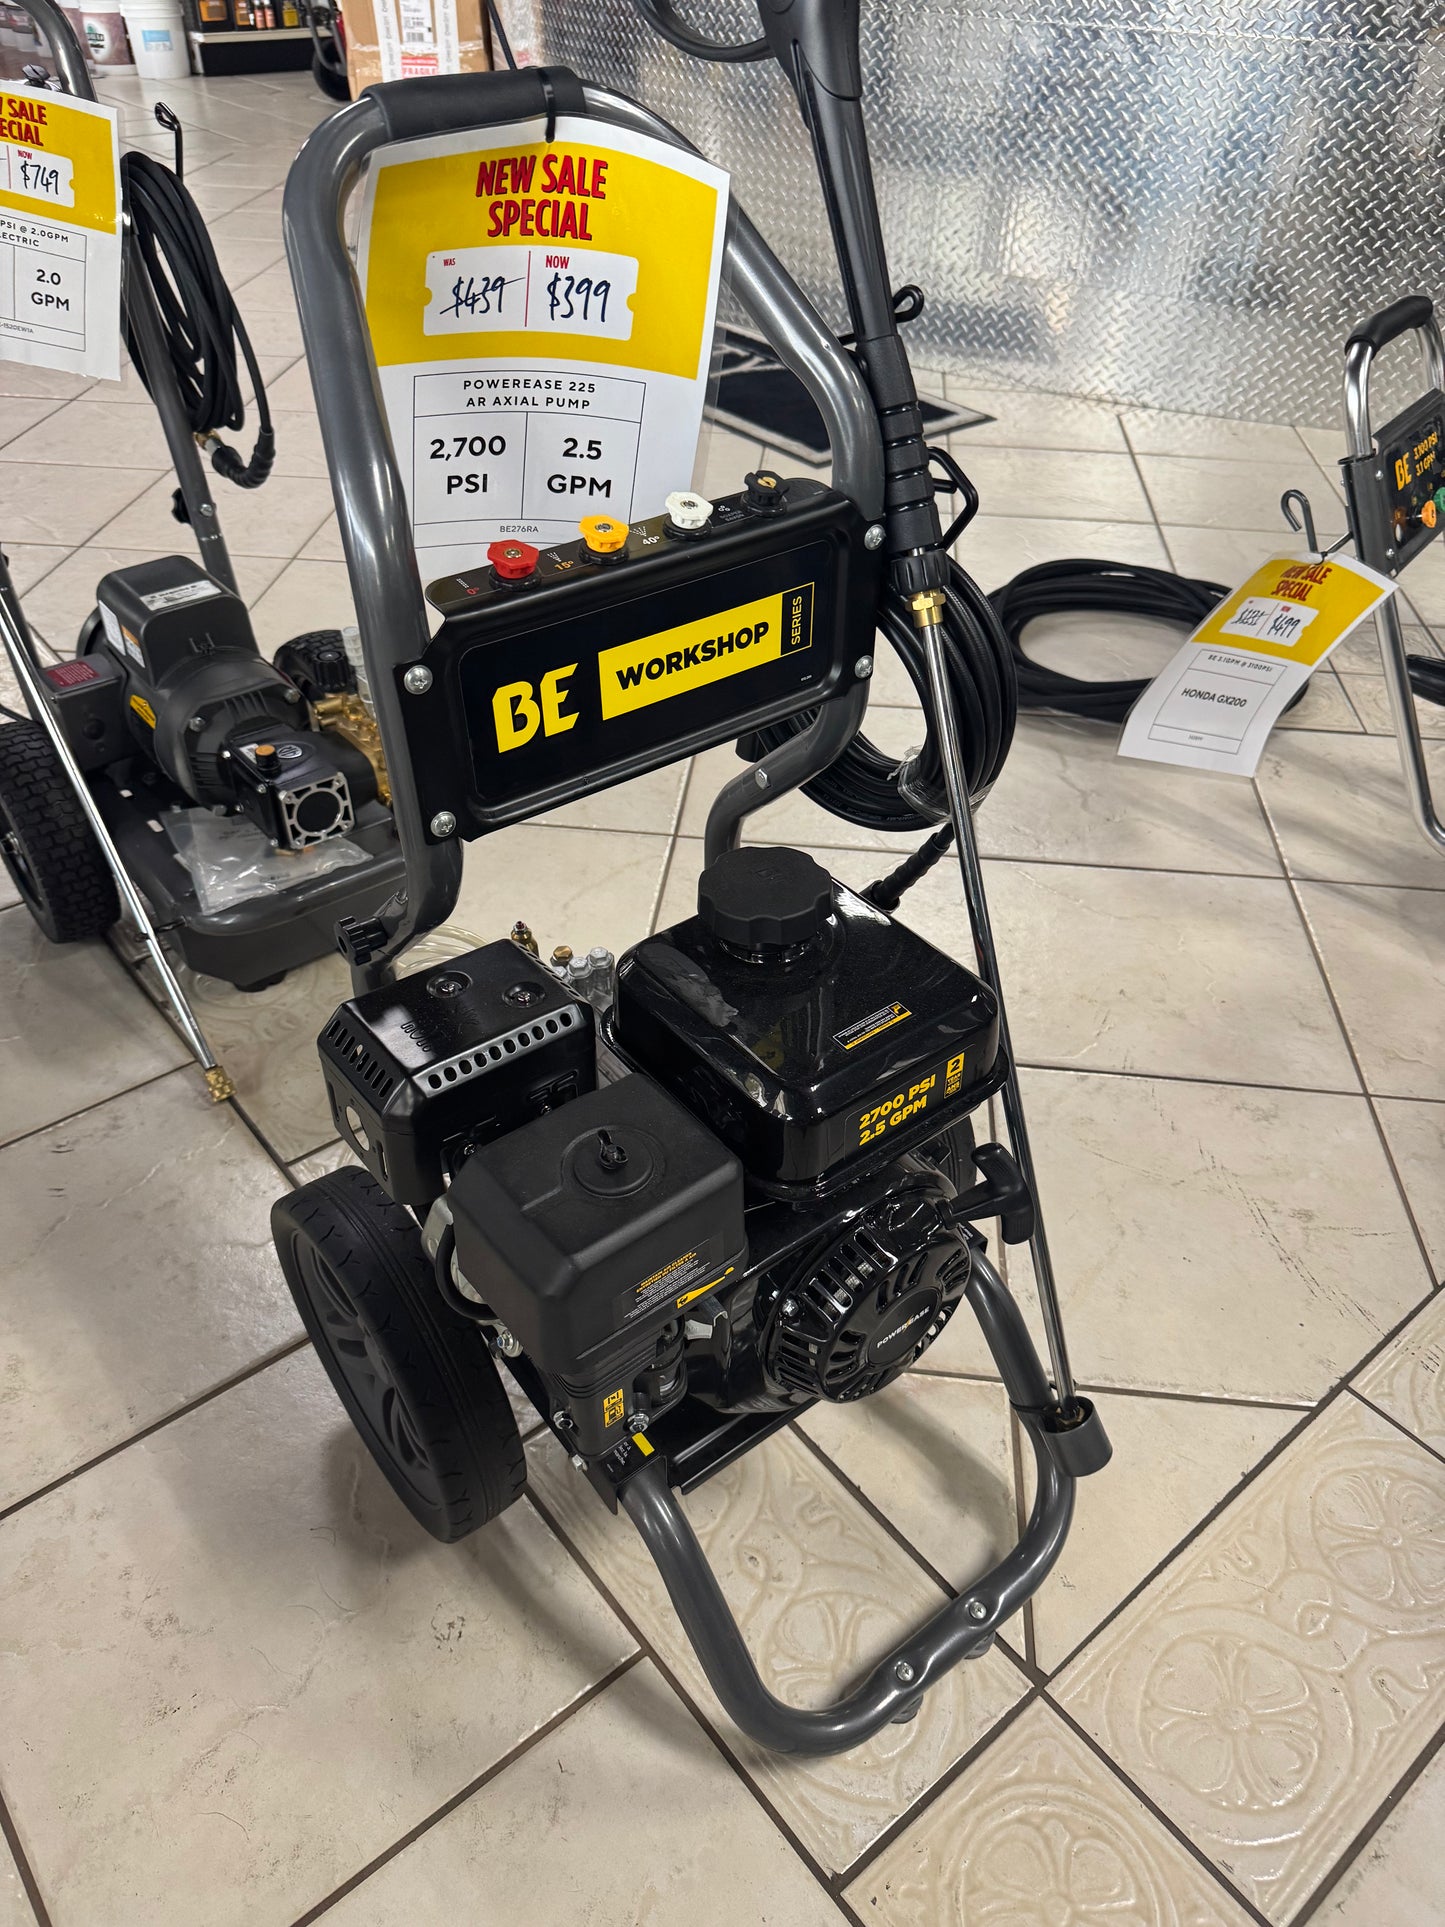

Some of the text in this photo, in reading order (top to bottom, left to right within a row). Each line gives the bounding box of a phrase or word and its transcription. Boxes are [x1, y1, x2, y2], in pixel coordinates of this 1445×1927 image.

[7, 98, 47, 126] SALE
[17, 149, 33, 160] NOW
[20, 160, 59, 195] $749
[475, 154, 608, 199] NEW SALE
[487, 199, 593, 241] SPECIAL
[0, 231, 40, 247] ECTRIC
[20, 225, 27, 233] @
[31, 227, 68, 243] 2.0GPM
[443, 255, 570, 269] WAS NOW
[36, 268, 62, 286] 2.0
[31, 291, 70, 312] GPM
[452, 271, 611, 322] $439 $399
[463, 377, 596, 394] POWEREASE 225
[466, 395, 591, 410] AR AXIAL PUMP
[429, 435, 602, 461] 2,700 2.5
[1395, 452, 1412, 491] BE
[447, 473, 612, 498] PSI GPM
[499, 525, 539, 534] BE276RA
[554, 560, 574, 571] 15°
[1280, 565, 1333, 584] NEW SALE
[1270, 580, 1313, 602] SPECIAL
[791, 595, 803, 646] SERIES
[491, 621, 769, 754] BE WORKSHOP
[1181, 687, 1248, 708] HONDA GX200
[950, 1058, 961, 1073] 2
[859, 1073, 936, 1130] 2700 PSI
[859, 1094, 927, 1146] 2.5 GPM
